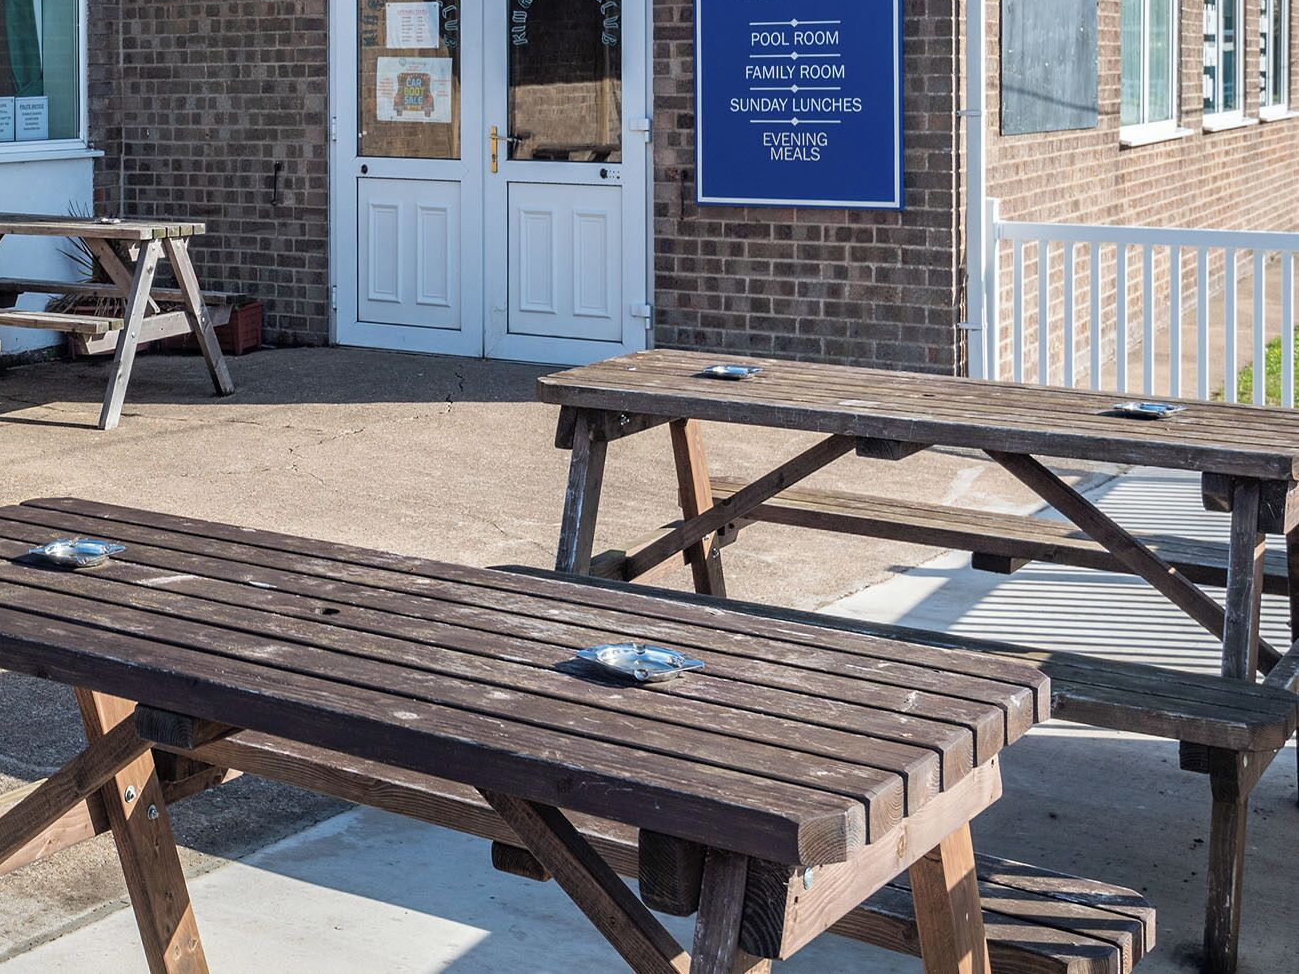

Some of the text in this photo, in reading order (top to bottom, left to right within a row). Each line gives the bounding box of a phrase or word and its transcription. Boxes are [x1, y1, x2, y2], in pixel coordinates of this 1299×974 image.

[751, 31, 839, 46] POOL ROOM
[745, 64, 845, 79] FAMILY ROOM
[405, 77, 422, 87] CAR
[730, 97, 862, 112] SUNDAY LUNCHES
[763, 132, 828, 147] EVENING
[770, 147, 821, 162] MEALS
